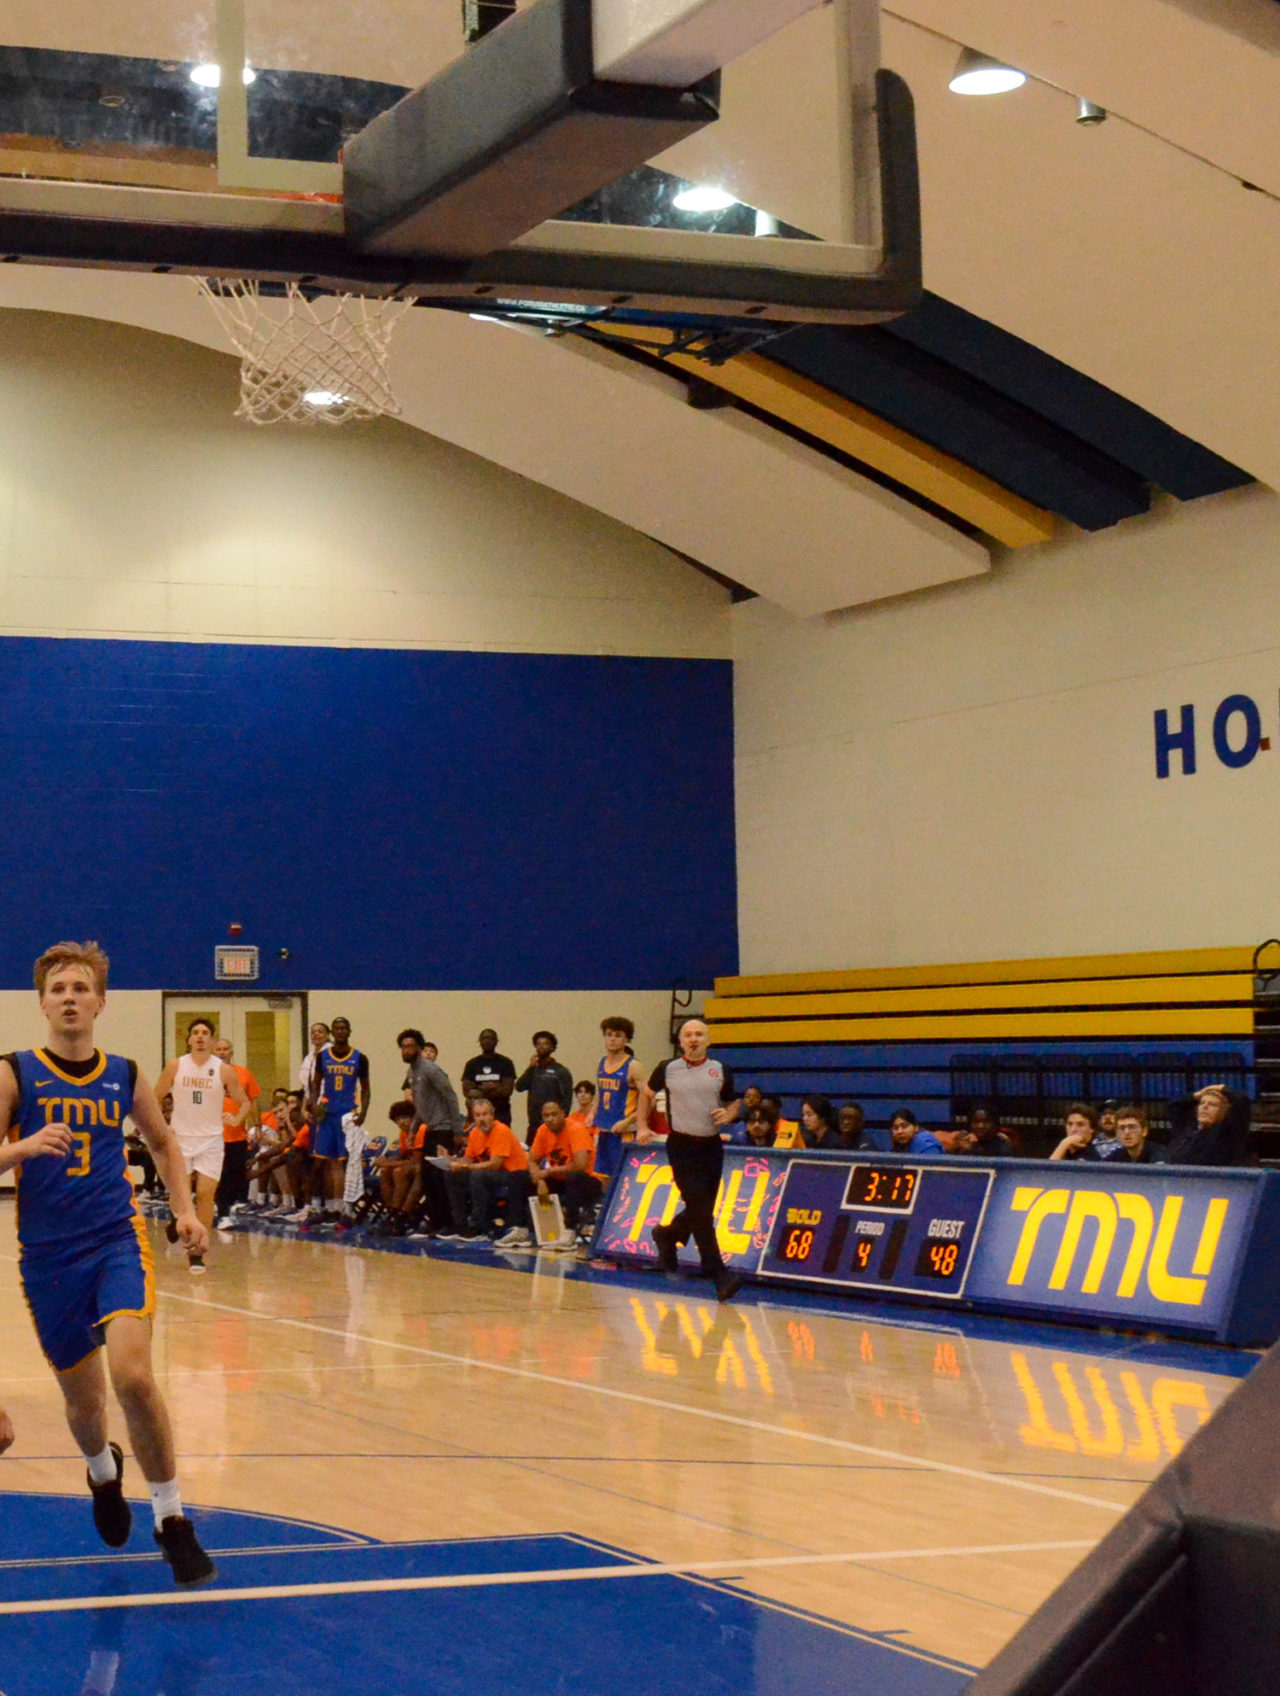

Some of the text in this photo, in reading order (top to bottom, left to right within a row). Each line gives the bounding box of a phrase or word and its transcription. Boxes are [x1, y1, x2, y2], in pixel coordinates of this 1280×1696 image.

[1153, 694, 1280, 779] HO
[182, 1076, 212, 1089] UNBC
[37, 1097, 120, 1126] TMU
[192, 1091, 202, 1104] 10
[66, 1131, 91, 1176] 3
[864, 1172, 914, 1201] 3:17
[786, 1208, 821, 1225] BOLD
[855, 1220, 885, 1236] PERIOD
[928, 1218, 965, 1238] GUEST
[786, 1229, 813, 1259] 68
[858, 1243, 871, 1267] 4
[1007, 1187, 1229, 1305] TMU
[930, 1244, 958, 1275] 48
